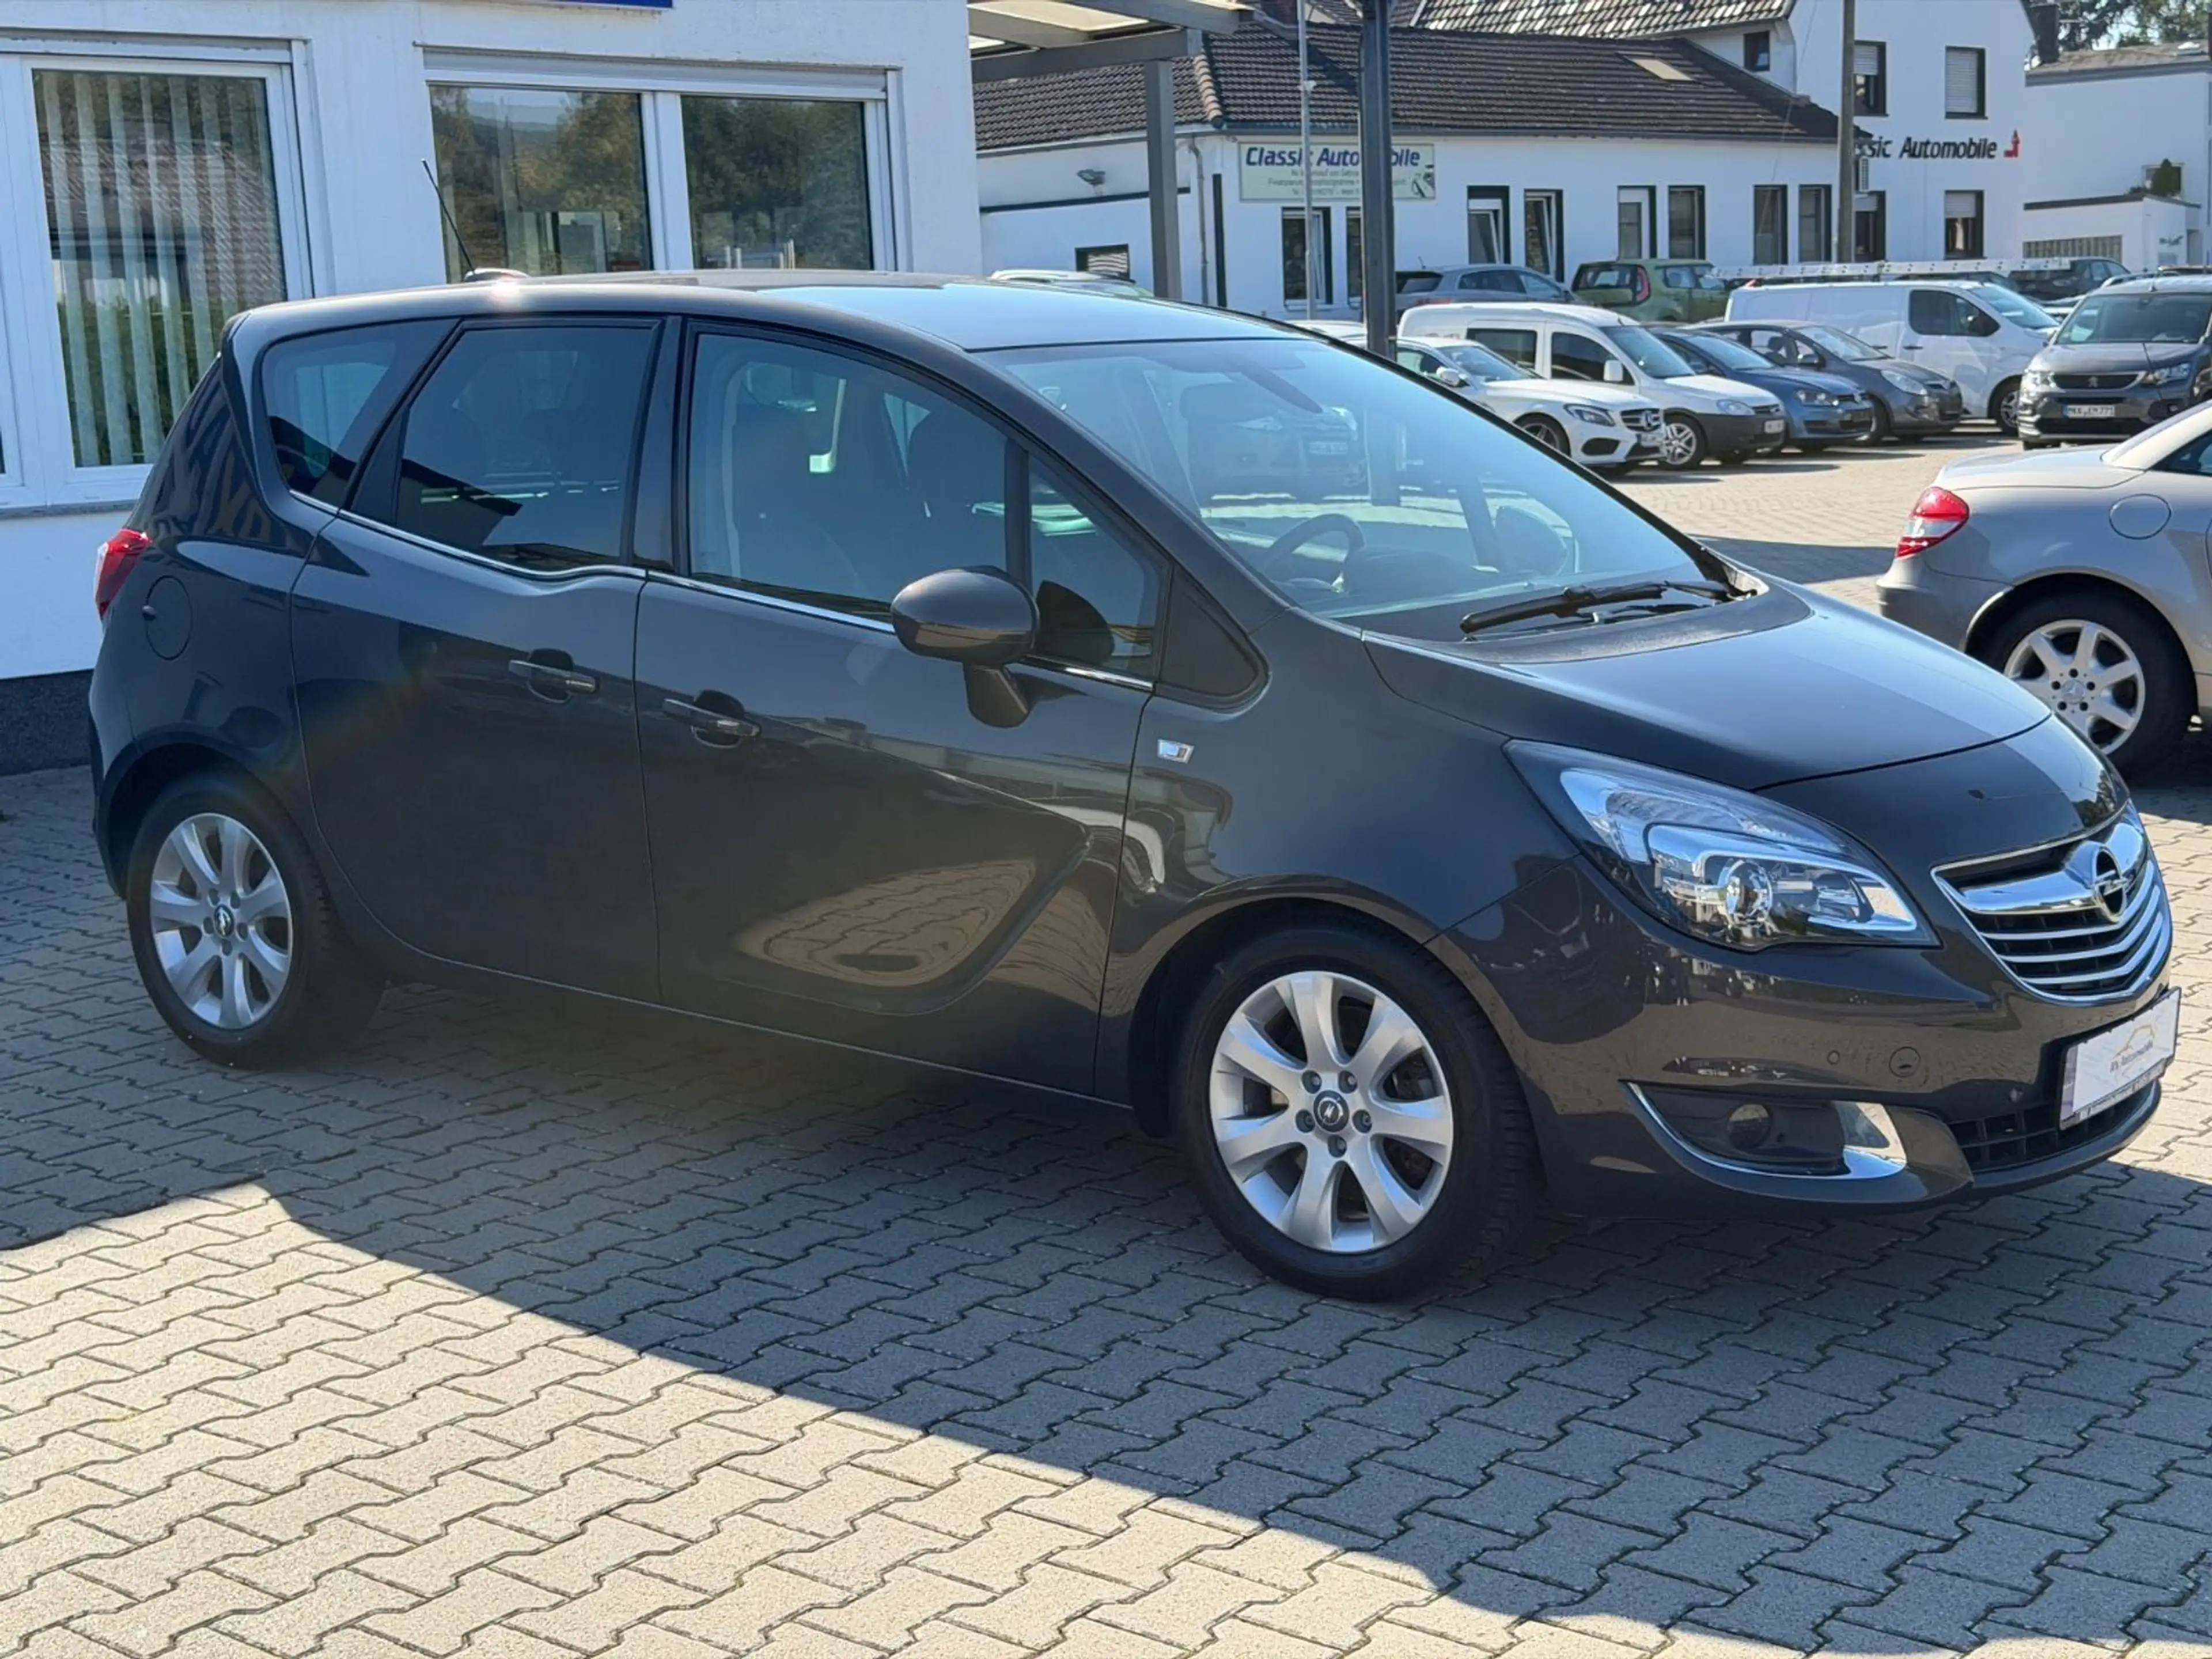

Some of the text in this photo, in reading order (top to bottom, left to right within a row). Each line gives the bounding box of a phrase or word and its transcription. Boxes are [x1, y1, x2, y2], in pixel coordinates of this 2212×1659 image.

[1245, 147, 1421, 166] Classi Autobile
[1899, 137, 1998, 159] Automobile
